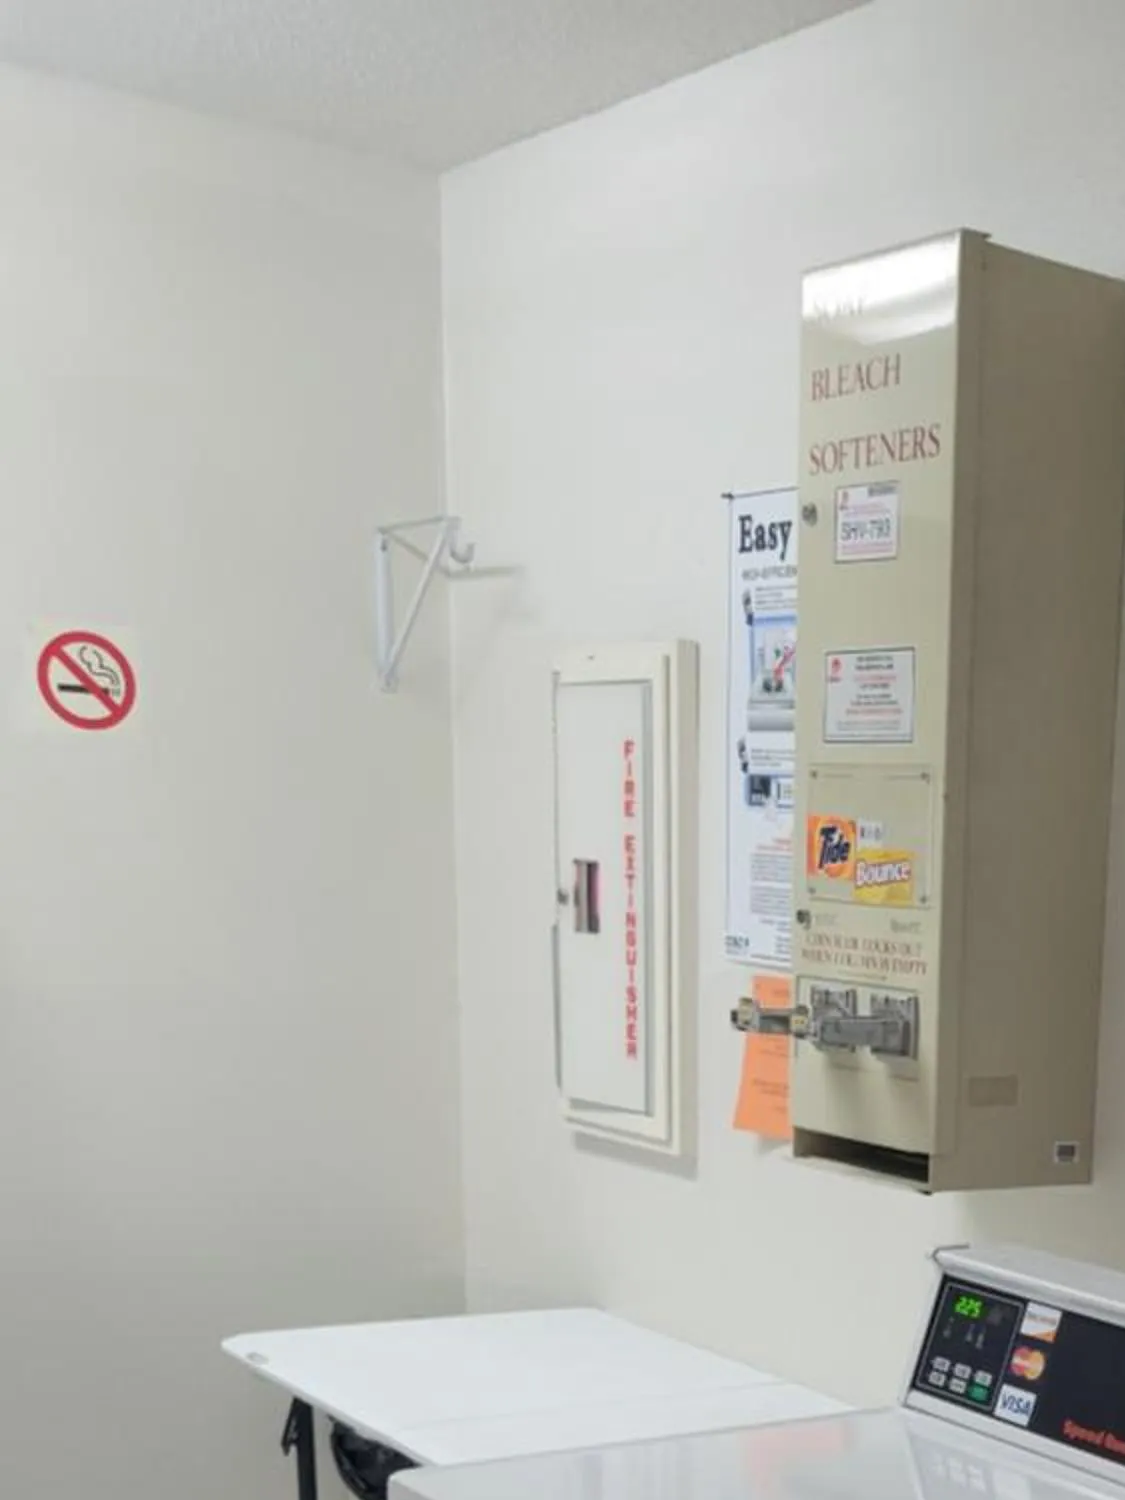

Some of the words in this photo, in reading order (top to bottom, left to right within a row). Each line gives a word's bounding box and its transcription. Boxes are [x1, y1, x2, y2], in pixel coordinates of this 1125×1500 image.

[811, 353, 902, 401] BLEACH
[809, 424, 941, 476] SOFTENERS
[738, 514, 793, 561] Easy
[623, 739, 637, 818] FIRE
[818, 825, 851, 870] Tide
[855, 861, 912, 888] Bounce
[624, 834, 638, 1061] EXTINGUISHER
[1002, 1392, 1033, 1417] VISA
